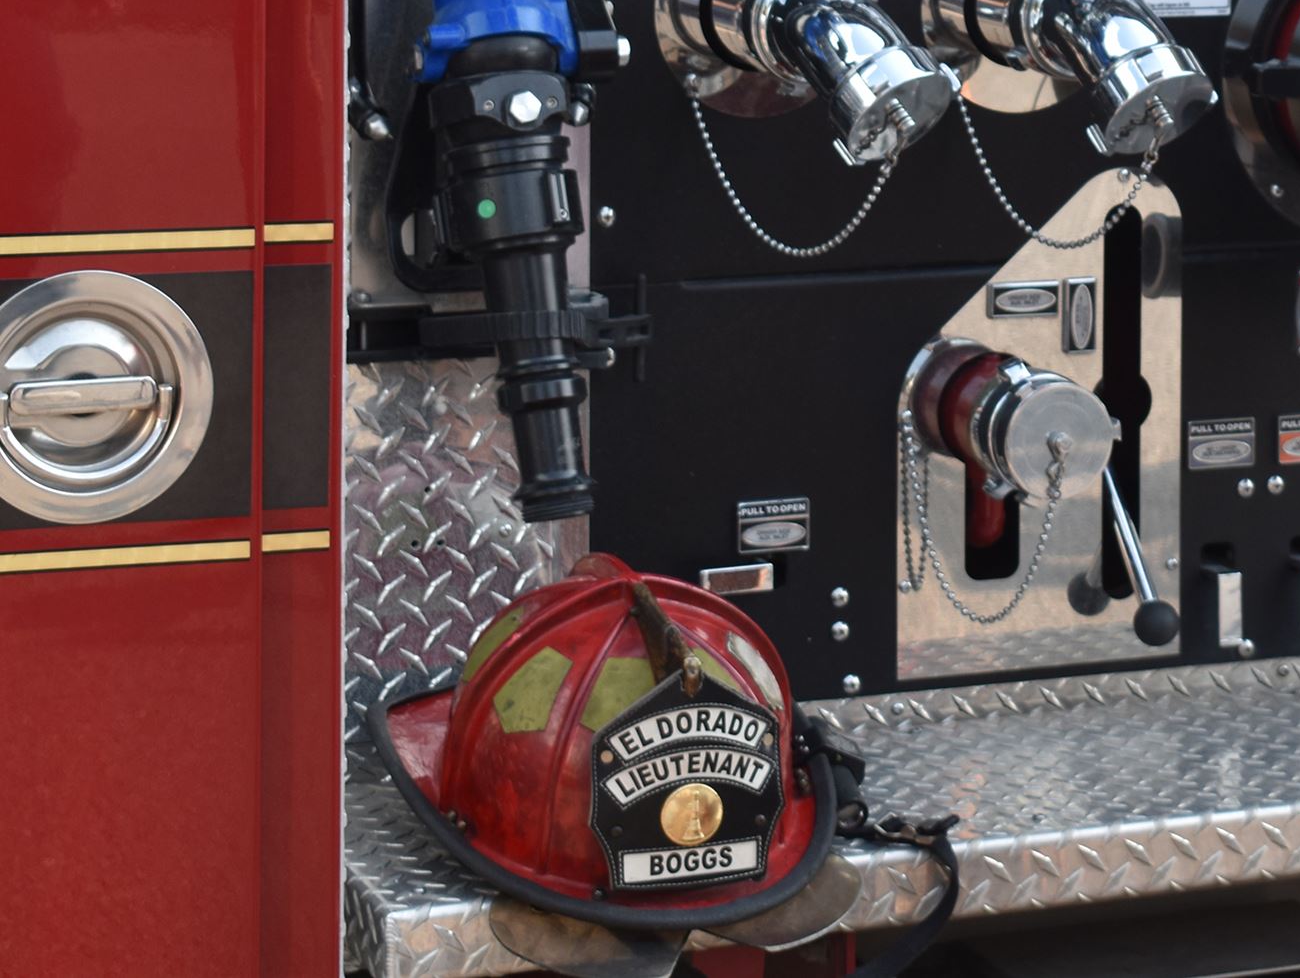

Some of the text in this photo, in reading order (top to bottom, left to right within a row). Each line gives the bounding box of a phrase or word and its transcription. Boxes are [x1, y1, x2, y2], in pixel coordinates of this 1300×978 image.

[1191, 425, 1211, 433] PULL
[1227, 422, 1251, 431] OPEN
[741, 503, 806, 516] PULL TO OPEN
[619, 709, 760, 756] EL DORADO
[615, 751, 764, 797] LIEUTENANT
[650, 846, 733, 876] BOGGS
